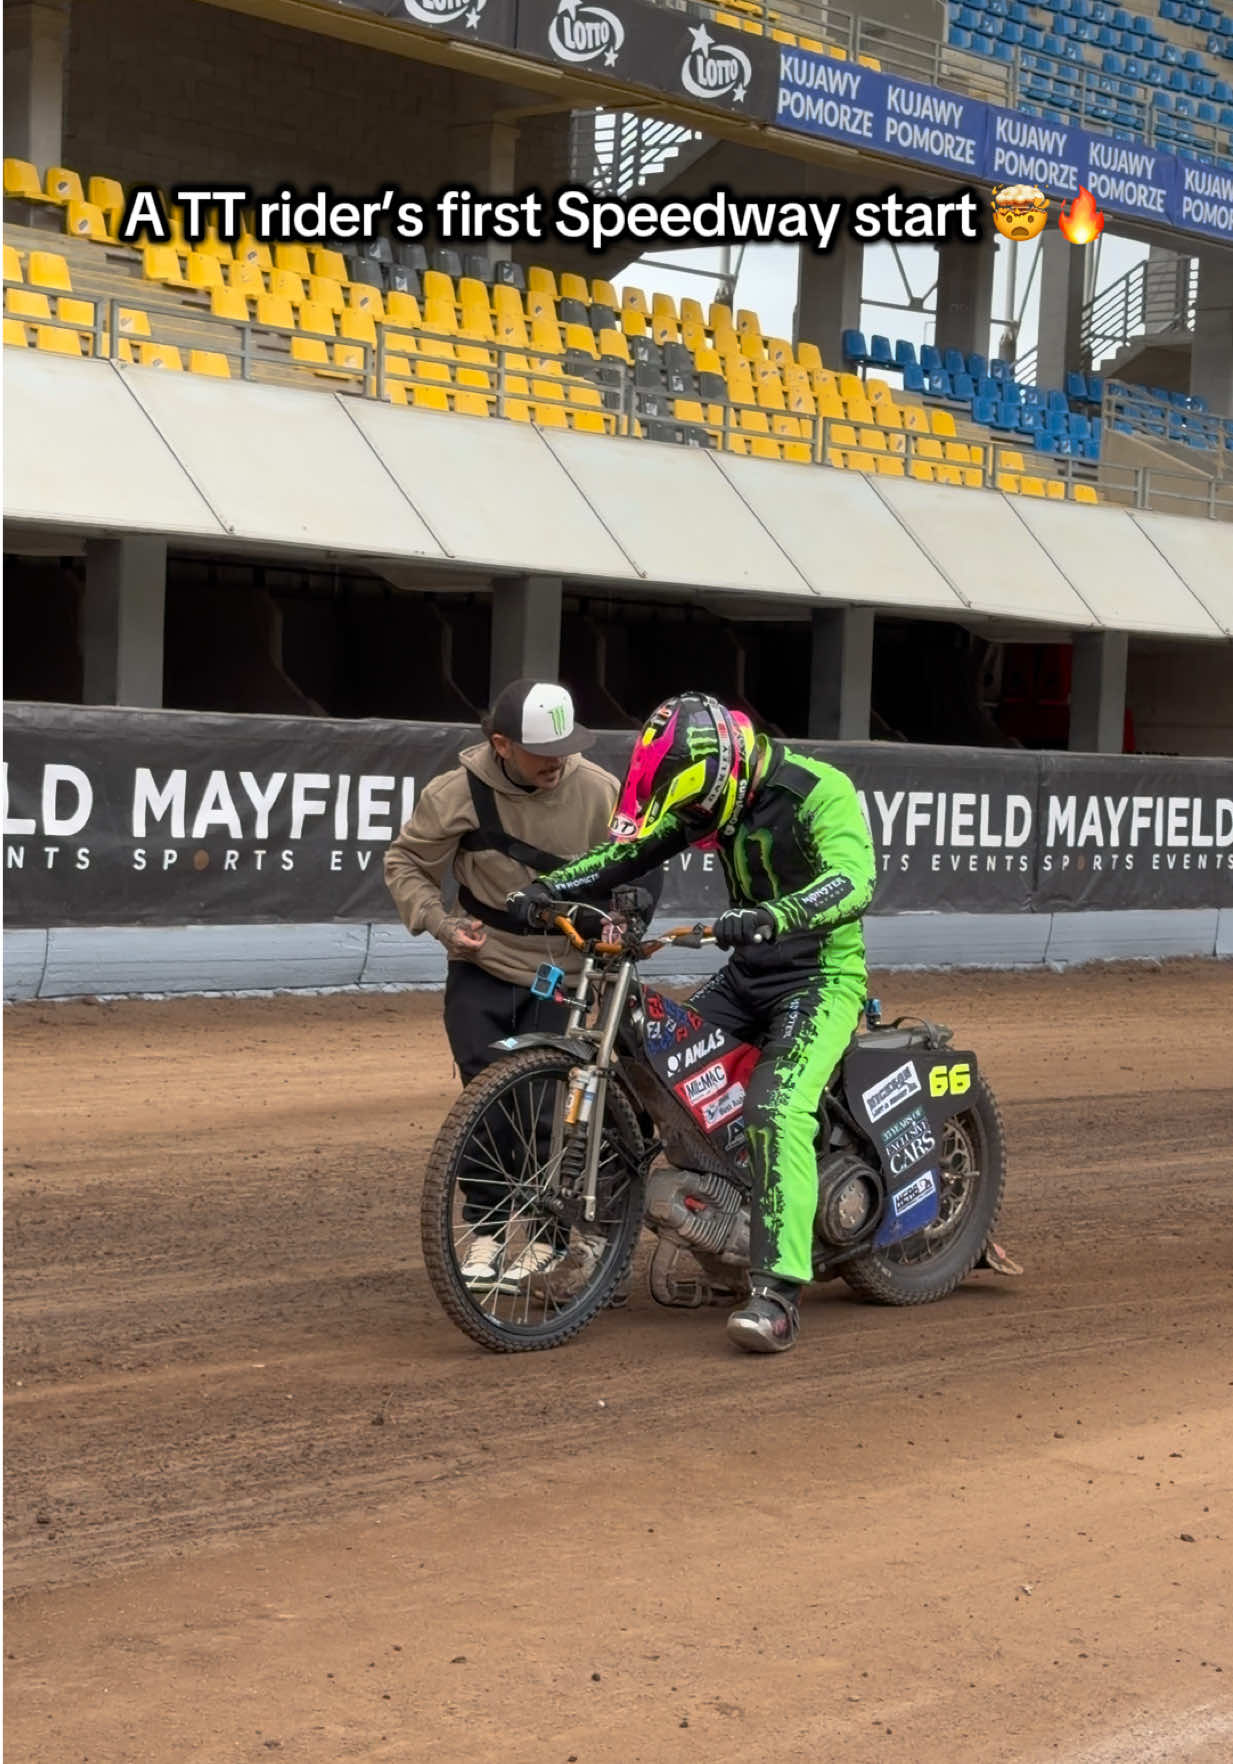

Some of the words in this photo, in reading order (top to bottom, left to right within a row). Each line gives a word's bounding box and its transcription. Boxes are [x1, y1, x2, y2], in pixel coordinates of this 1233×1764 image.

[563, 16, 610, 51] LOTTO
[697, 54, 739, 86] LOTTO
[779, 53, 862, 100] KUJAWY
[776, 87, 874, 138] POMORZE
[887, 84, 964, 129] KUJAWY
[885, 116, 976, 165] POMORZE
[995, 116, 1068, 157] KUJAWY
[993, 147, 1079, 191] POMORZE
[1088, 141, 1156, 180] KUJAWY
[1087, 171, 1167, 213] POMORZE
[132, 767, 415, 841] MAYFIE
[856, 789, 1033, 848] YFIELD
[1045, 795, 1233, 848] MAYFIELD
[931, 853, 1029, 872] EVENTS
[1042, 853, 1134, 872] SPORTS
[1152, 853, 1233, 871] EVENTS
[684, 1028, 725, 1068] ANLAS
[929, 1063, 970, 1097] 66
[889, 1131, 936, 1175] CARS
